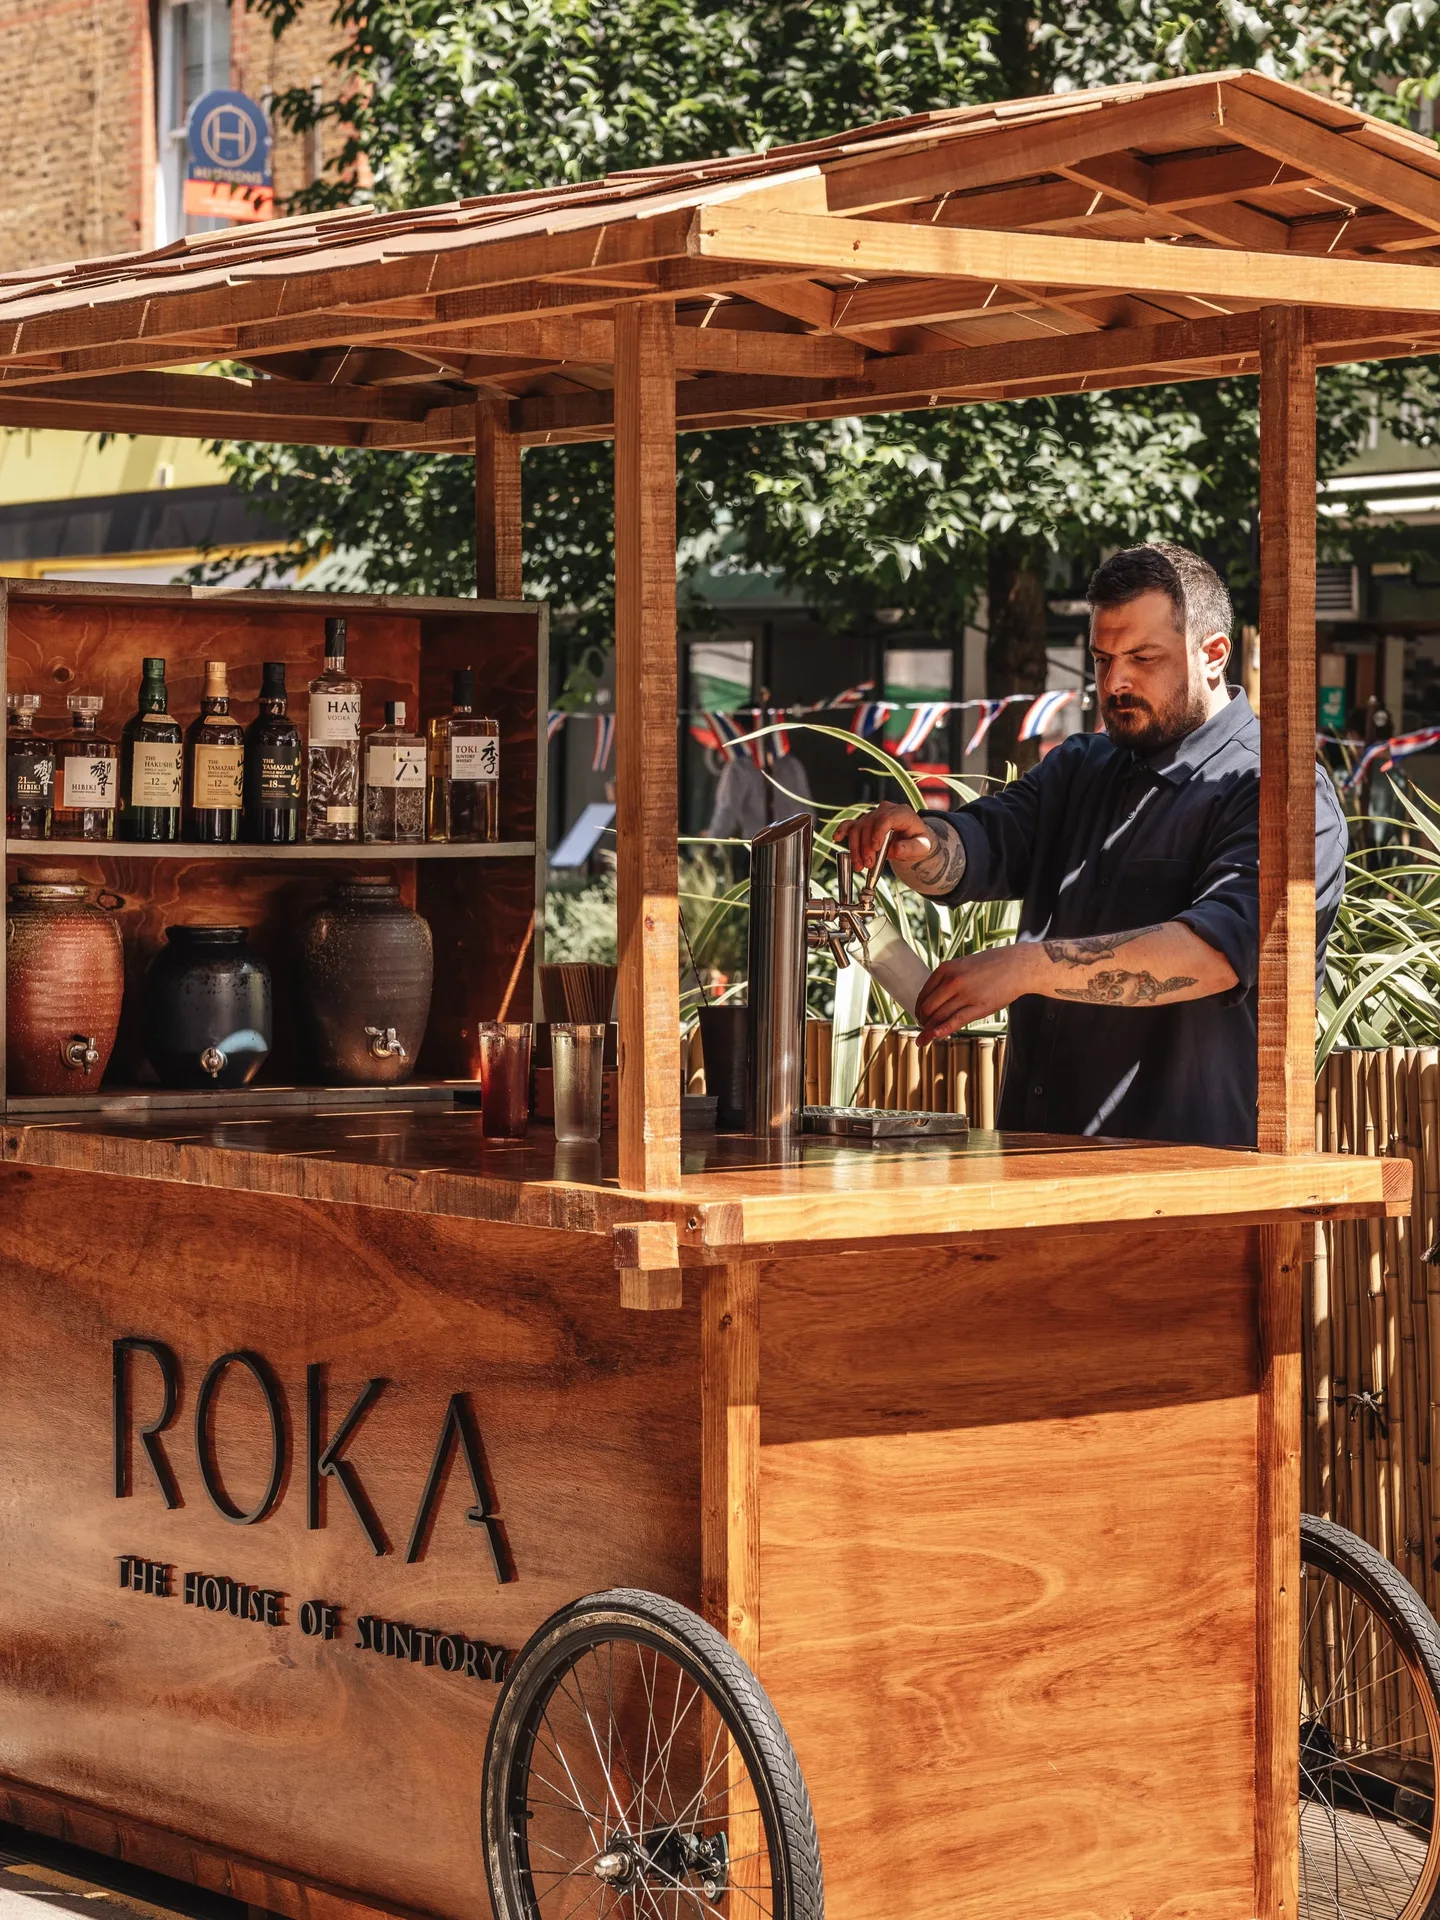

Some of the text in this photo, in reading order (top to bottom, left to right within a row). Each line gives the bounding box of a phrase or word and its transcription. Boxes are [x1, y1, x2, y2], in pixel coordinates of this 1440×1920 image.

[212, 112, 246, 158] H
[455, 745, 478, 753] TOKI
[17, 775, 28, 784] 21
[151, 777, 160, 786] 12
[214, 779, 222, 787] 12
[269, 779, 278, 788] 18
[113, 1337, 514, 1585] ROKA
[115, 1555, 506, 1684] THE HOUSE OF SUNTORY
